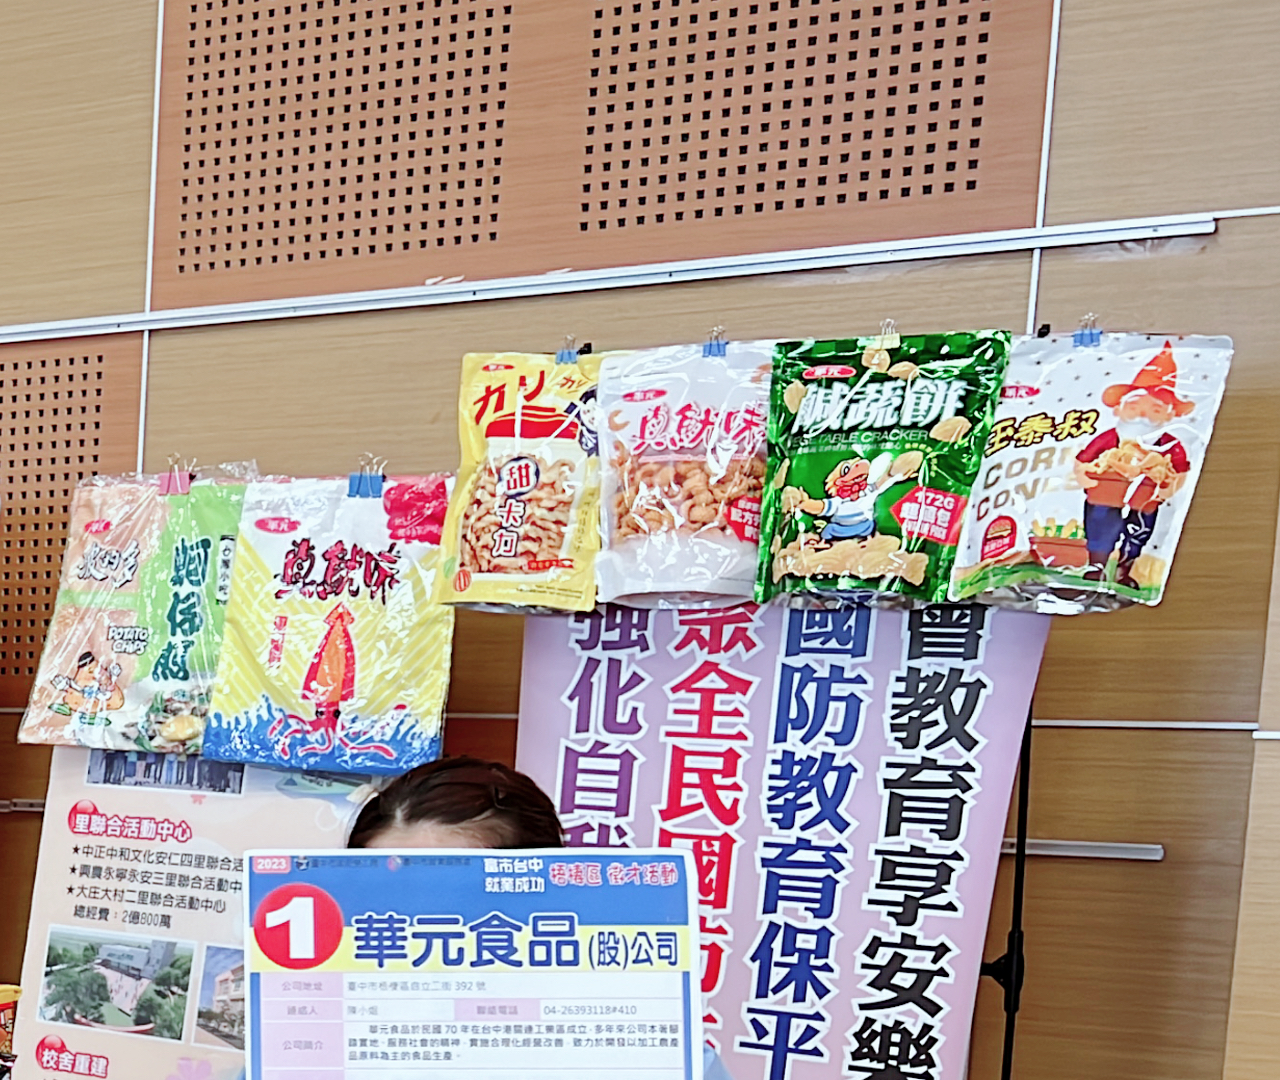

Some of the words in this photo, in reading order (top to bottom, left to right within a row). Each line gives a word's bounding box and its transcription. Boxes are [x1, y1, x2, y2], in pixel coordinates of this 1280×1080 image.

[791, 378, 967, 434] 鹹蔬餅
[861, 429, 928, 443] CRACKER
[984, 410, 1099, 458] 玉黍叔
[915, 491, 954, 509] 172G
[152, 538, 212, 682] 蚵仔煎
[109, 626, 148, 640] POTATO
[112, 640, 147, 654] CHIPS
[73, 813, 191, 842] 里聯合活動中心
[257, 858, 286, 870] 2023
[484, 858, 543, 873] 富市台中
[549, 863, 602, 885] 梧棲區
[607, 862, 678, 885] 徵才活動
[485, 877, 544, 892] 就業成功
[76, 885, 226, 914] 大庄大村二里聯合活動中心
[266, 897, 315, 959] 1
[455, 982, 473, 992] 392
[477, 981, 487, 992] 號
[544, 1005, 637, 1015] 04-26393118#410
[445, 1025, 458, 1035] 70
[42, 1049, 108, 1077] 校舍重建
